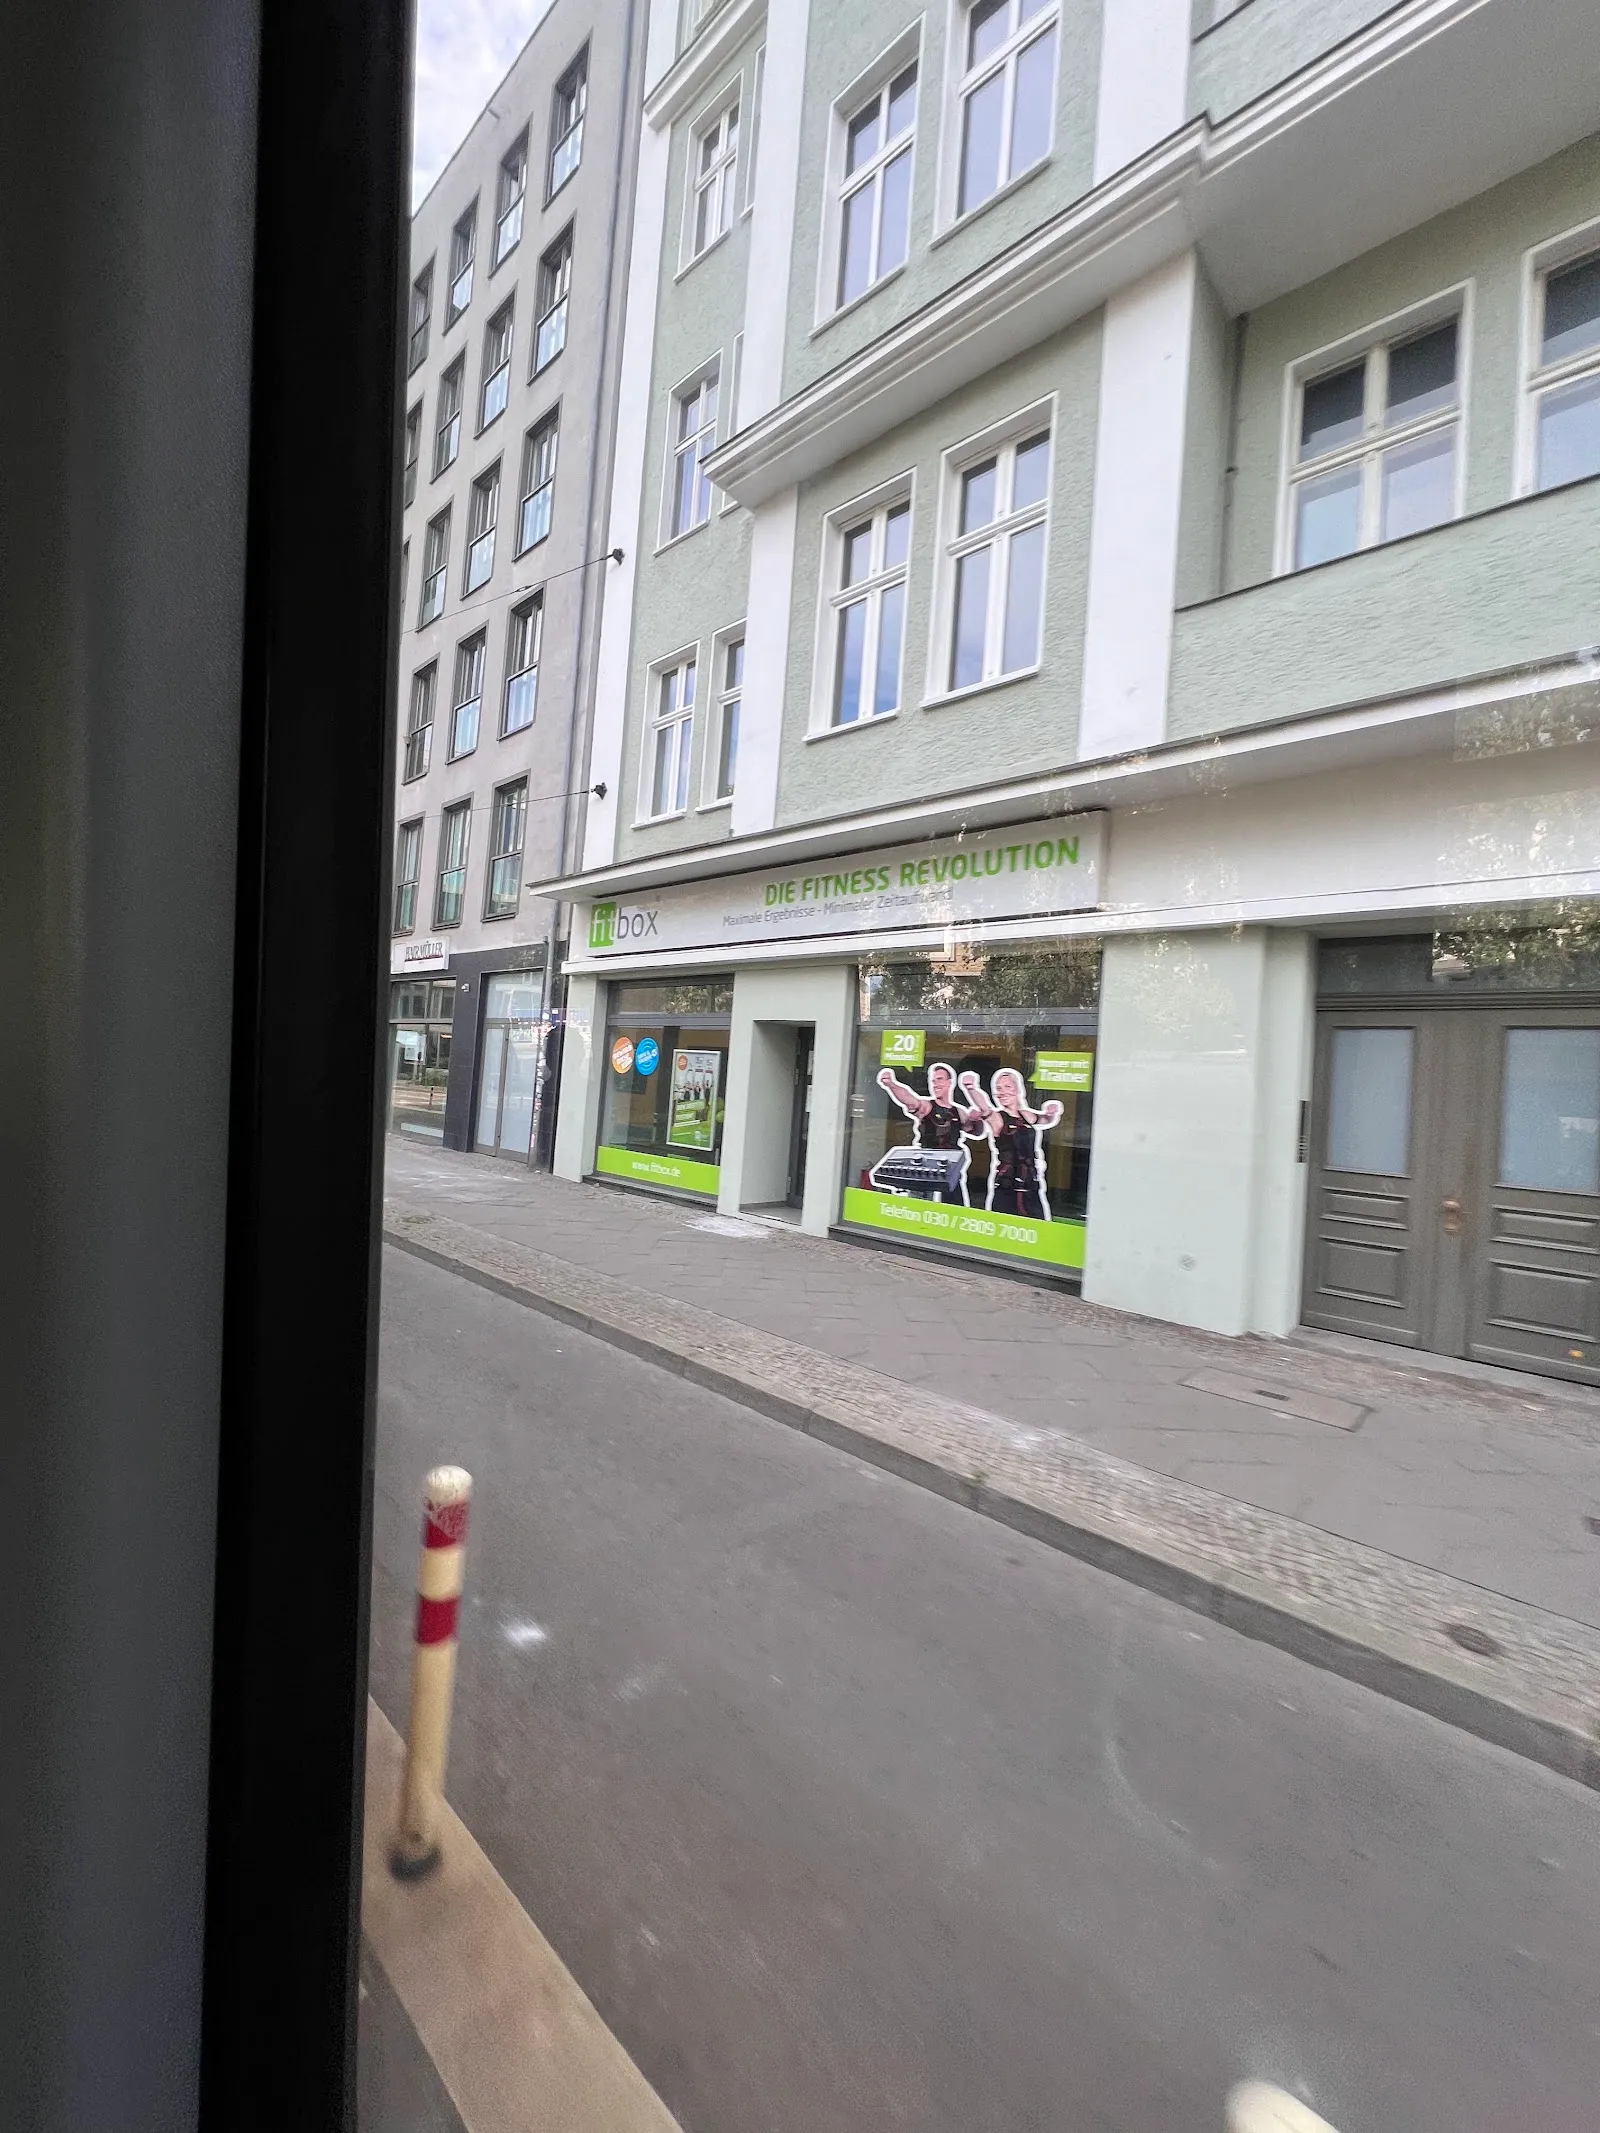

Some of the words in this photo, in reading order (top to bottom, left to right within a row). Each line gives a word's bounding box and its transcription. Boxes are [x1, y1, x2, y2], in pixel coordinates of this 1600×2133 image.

[765, 881, 797, 906] DIE
[801, 865, 892, 901] FITNESS
[900, 836, 1081, 887] REVOLUTION
[592, 906, 659, 943] fitbox
[722, 911, 763, 927] Maximale
[763, 905, 815, 924] Ergebnisse
[823, 899, 875, 916] Minimaler
[1039, 1069, 1089, 1084] Trainer
[880, 1202, 921, 1222] Telefon
[923, 1210, 949, 1227] 030
[950, 1215, 959, 1228] /
[959, 1216, 996, 1237] 2809
[998, 1223, 1038, 1244] 7000
